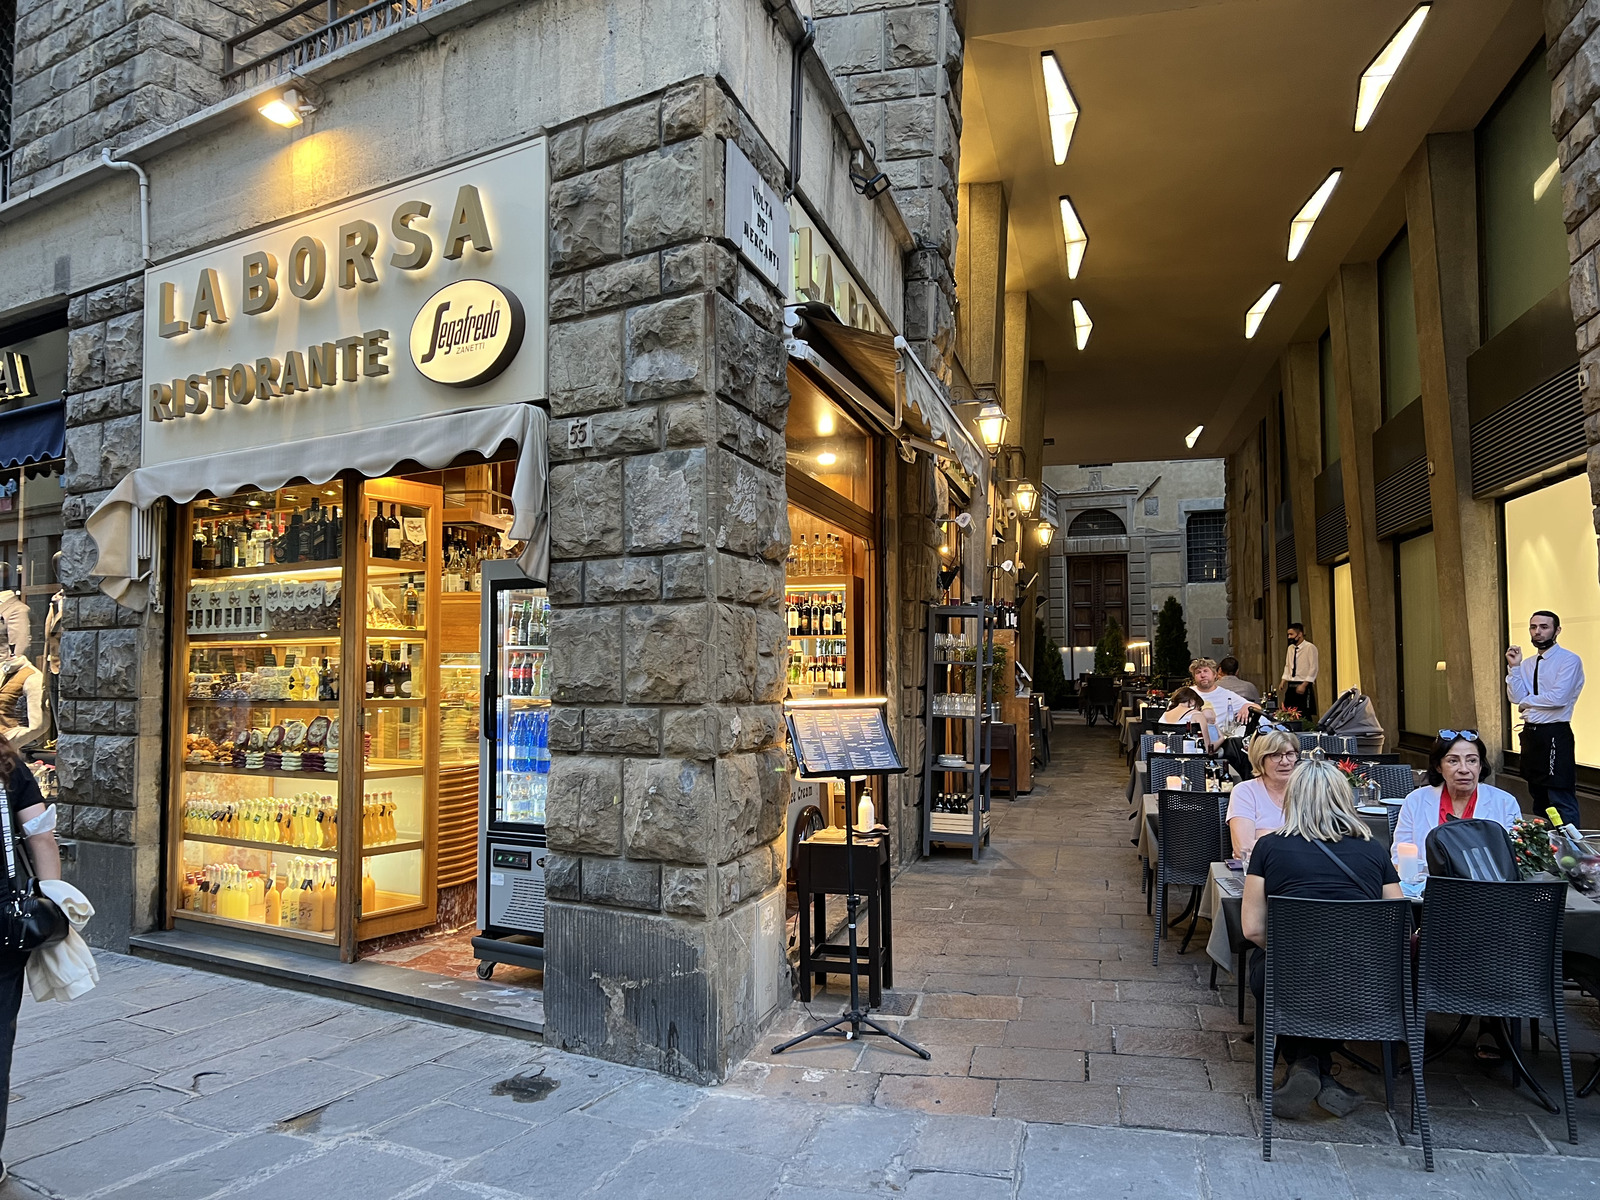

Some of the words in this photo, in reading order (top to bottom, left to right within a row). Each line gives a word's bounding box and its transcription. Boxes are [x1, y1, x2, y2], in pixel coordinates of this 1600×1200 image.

[751, 185, 773, 221] VOLTA
[756, 212, 768, 236] DEI
[158, 267, 228, 339] LA
[242, 184, 492, 316] BORSA
[743, 220, 780, 271] MERCANTI
[420, 299, 501, 364] Segafredo
[456, 342, 485, 355] ZANETTI
[149, 328, 390, 422] RISTORANTE
[569, 421, 588, 445] 55
[797, 785, 813, 801] Cream
